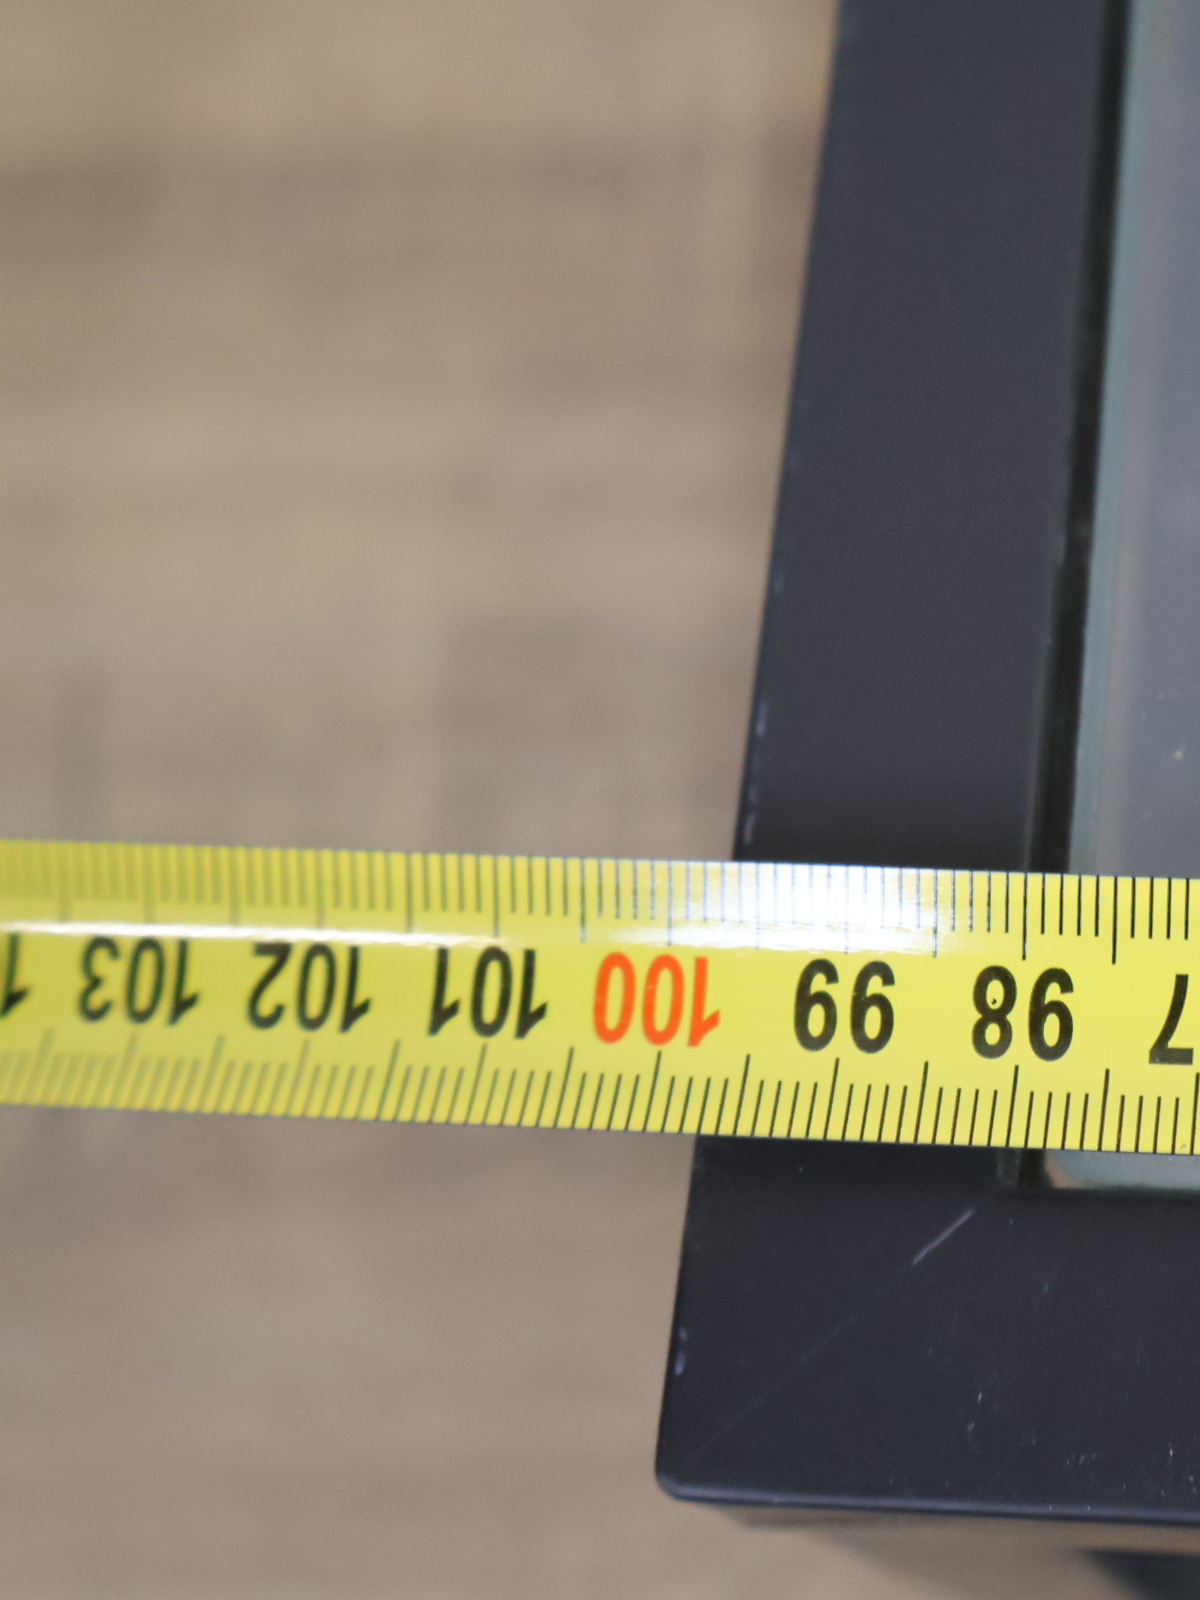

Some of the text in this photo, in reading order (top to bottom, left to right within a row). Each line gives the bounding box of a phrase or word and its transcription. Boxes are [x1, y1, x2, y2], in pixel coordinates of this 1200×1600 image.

[76, 936, 200, 1026] 103
[246, 941, 371, 1033] 102
[427, 946, 548, 1039] 101
[592, 951, 722, 1048] 100
[794, 958, 895, 1054] 99
[972, 965, 1074, 1062] 98
